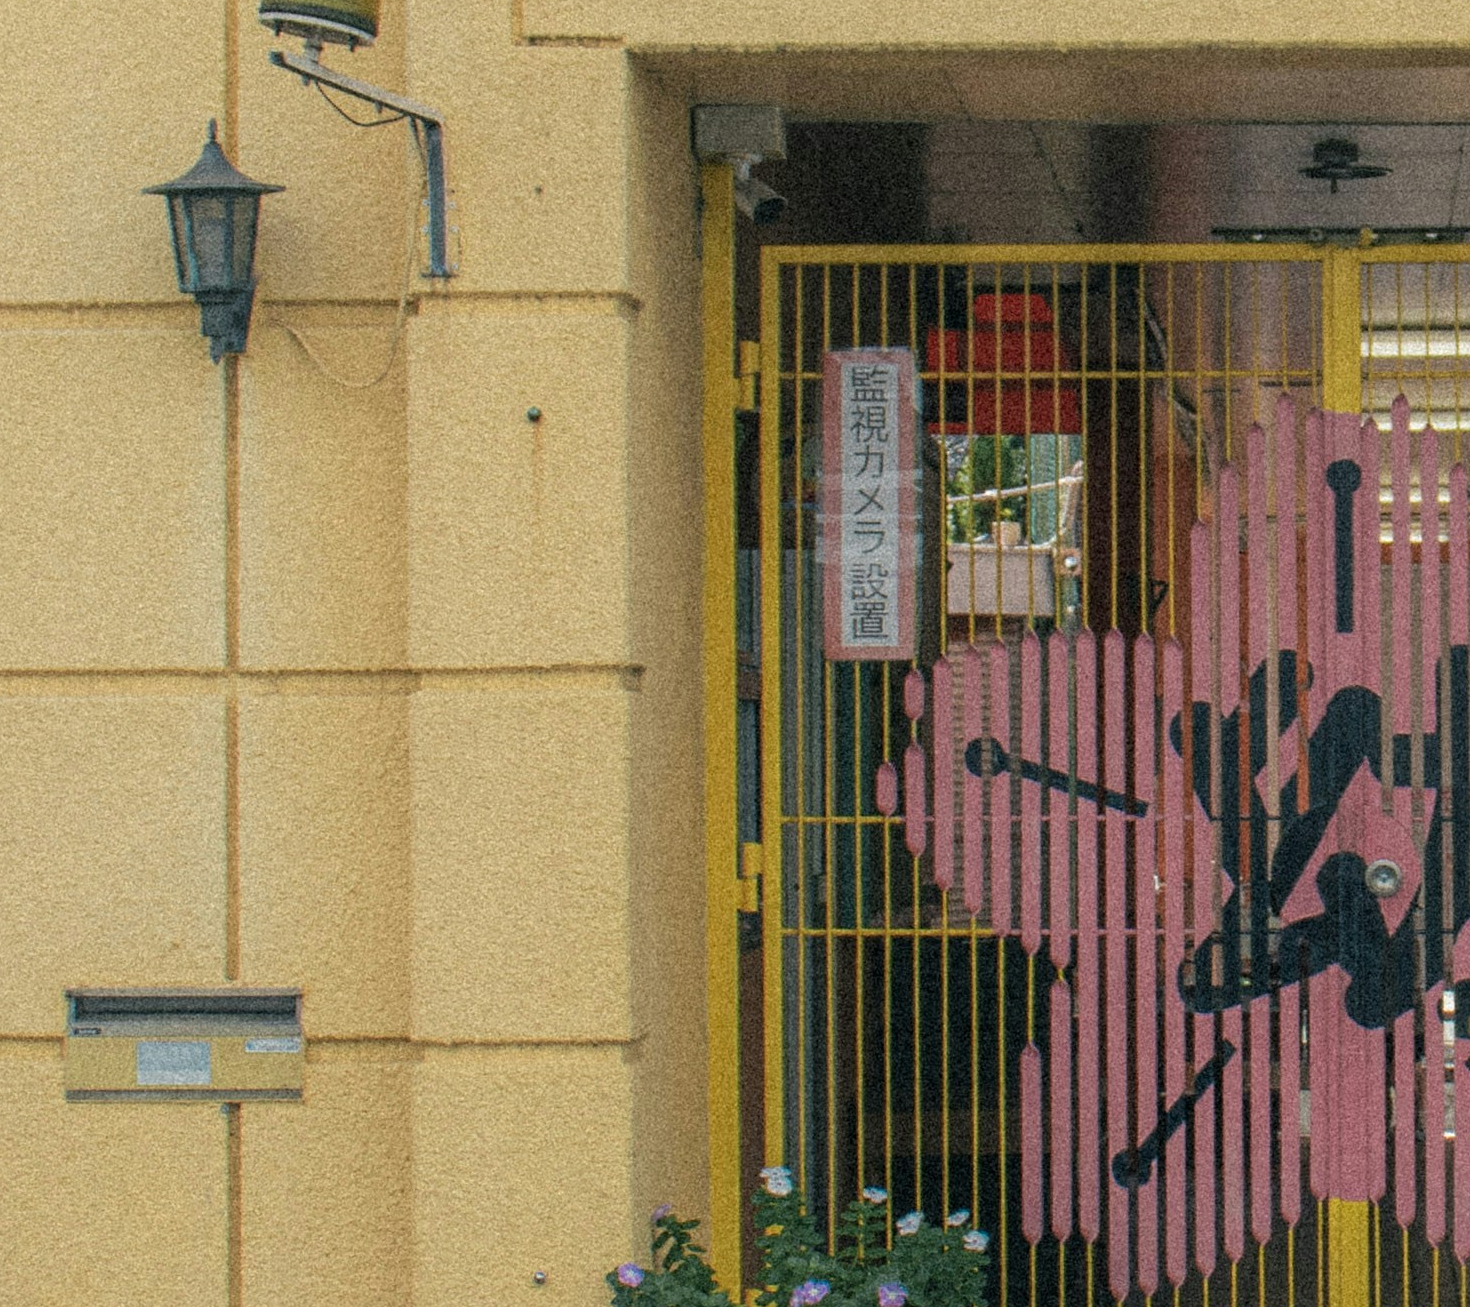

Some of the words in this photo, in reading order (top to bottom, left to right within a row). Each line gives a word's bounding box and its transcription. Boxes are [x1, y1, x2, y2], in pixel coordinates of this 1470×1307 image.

[849, 364, 890, 641] 監視カメラ設置
